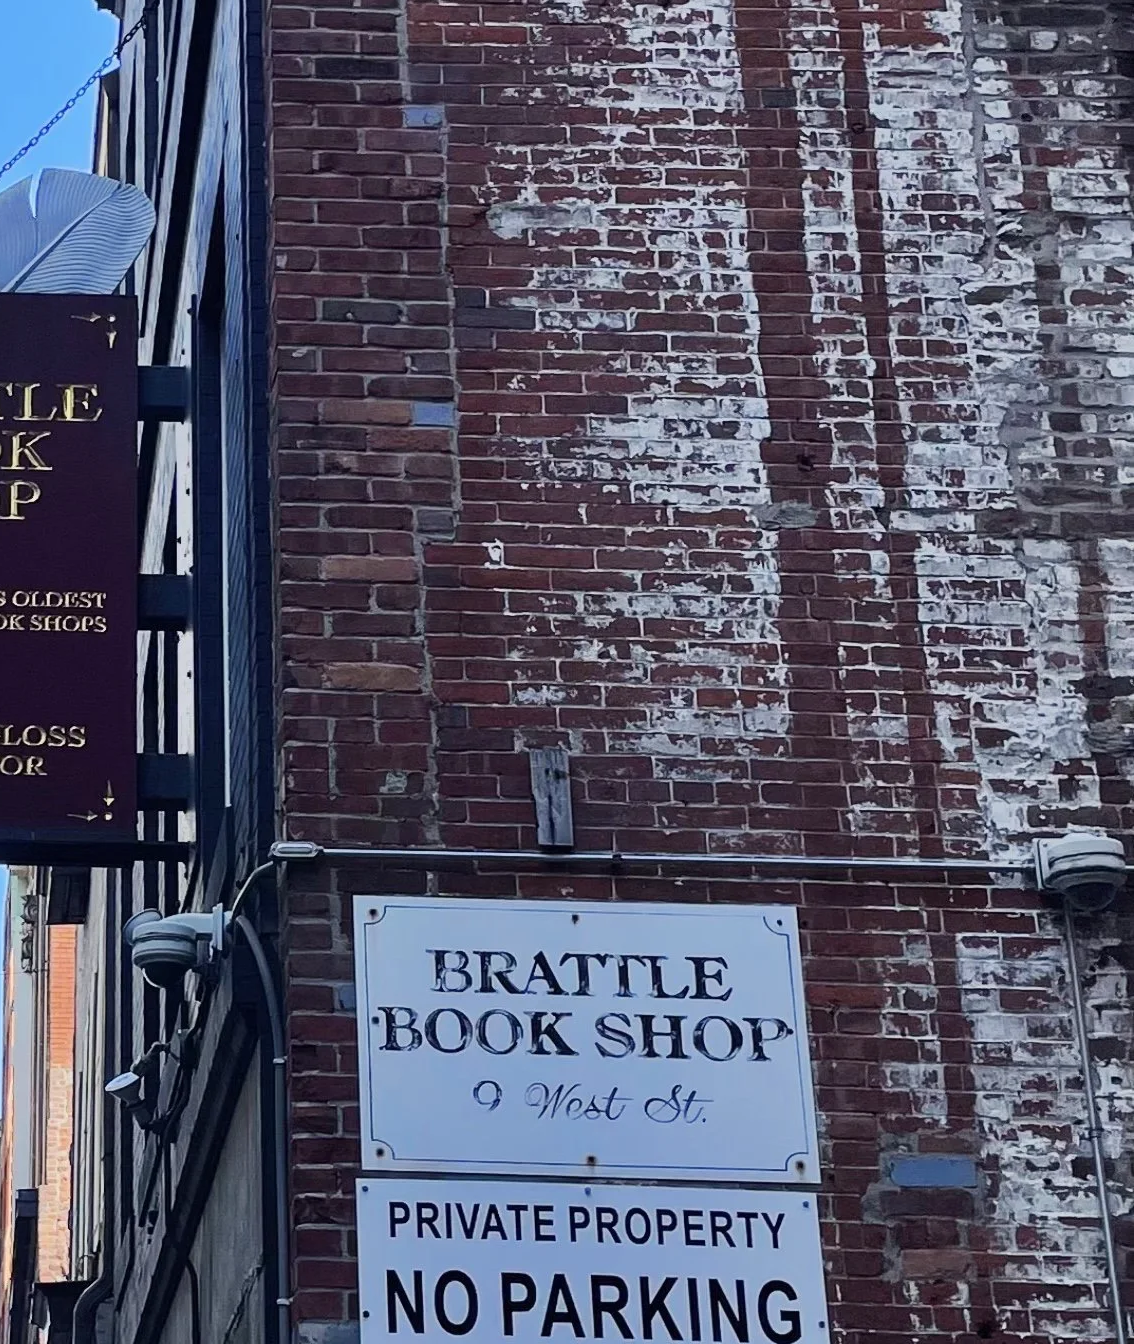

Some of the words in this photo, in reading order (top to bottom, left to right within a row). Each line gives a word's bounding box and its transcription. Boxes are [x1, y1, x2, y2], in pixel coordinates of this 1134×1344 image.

[12, 590, 106, 609] OLDEST
[29, 614, 107, 633] SHOPS
[425, 949, 733, 1002] BRATTLE
[378, 1007, 579, 1058] BOOK
[594, 1012, 790, 1061] SHOP
[472, 1080, 503, 1111] 9
[524, 1082, 635, 1122] West
[644, 1085, 714, 1124] St.
[389, 1201, 556, 1242] PRIVATE
[569, 1207, 785, 1250] PROPERTY
[385, 1269, 479, 1335] NO
